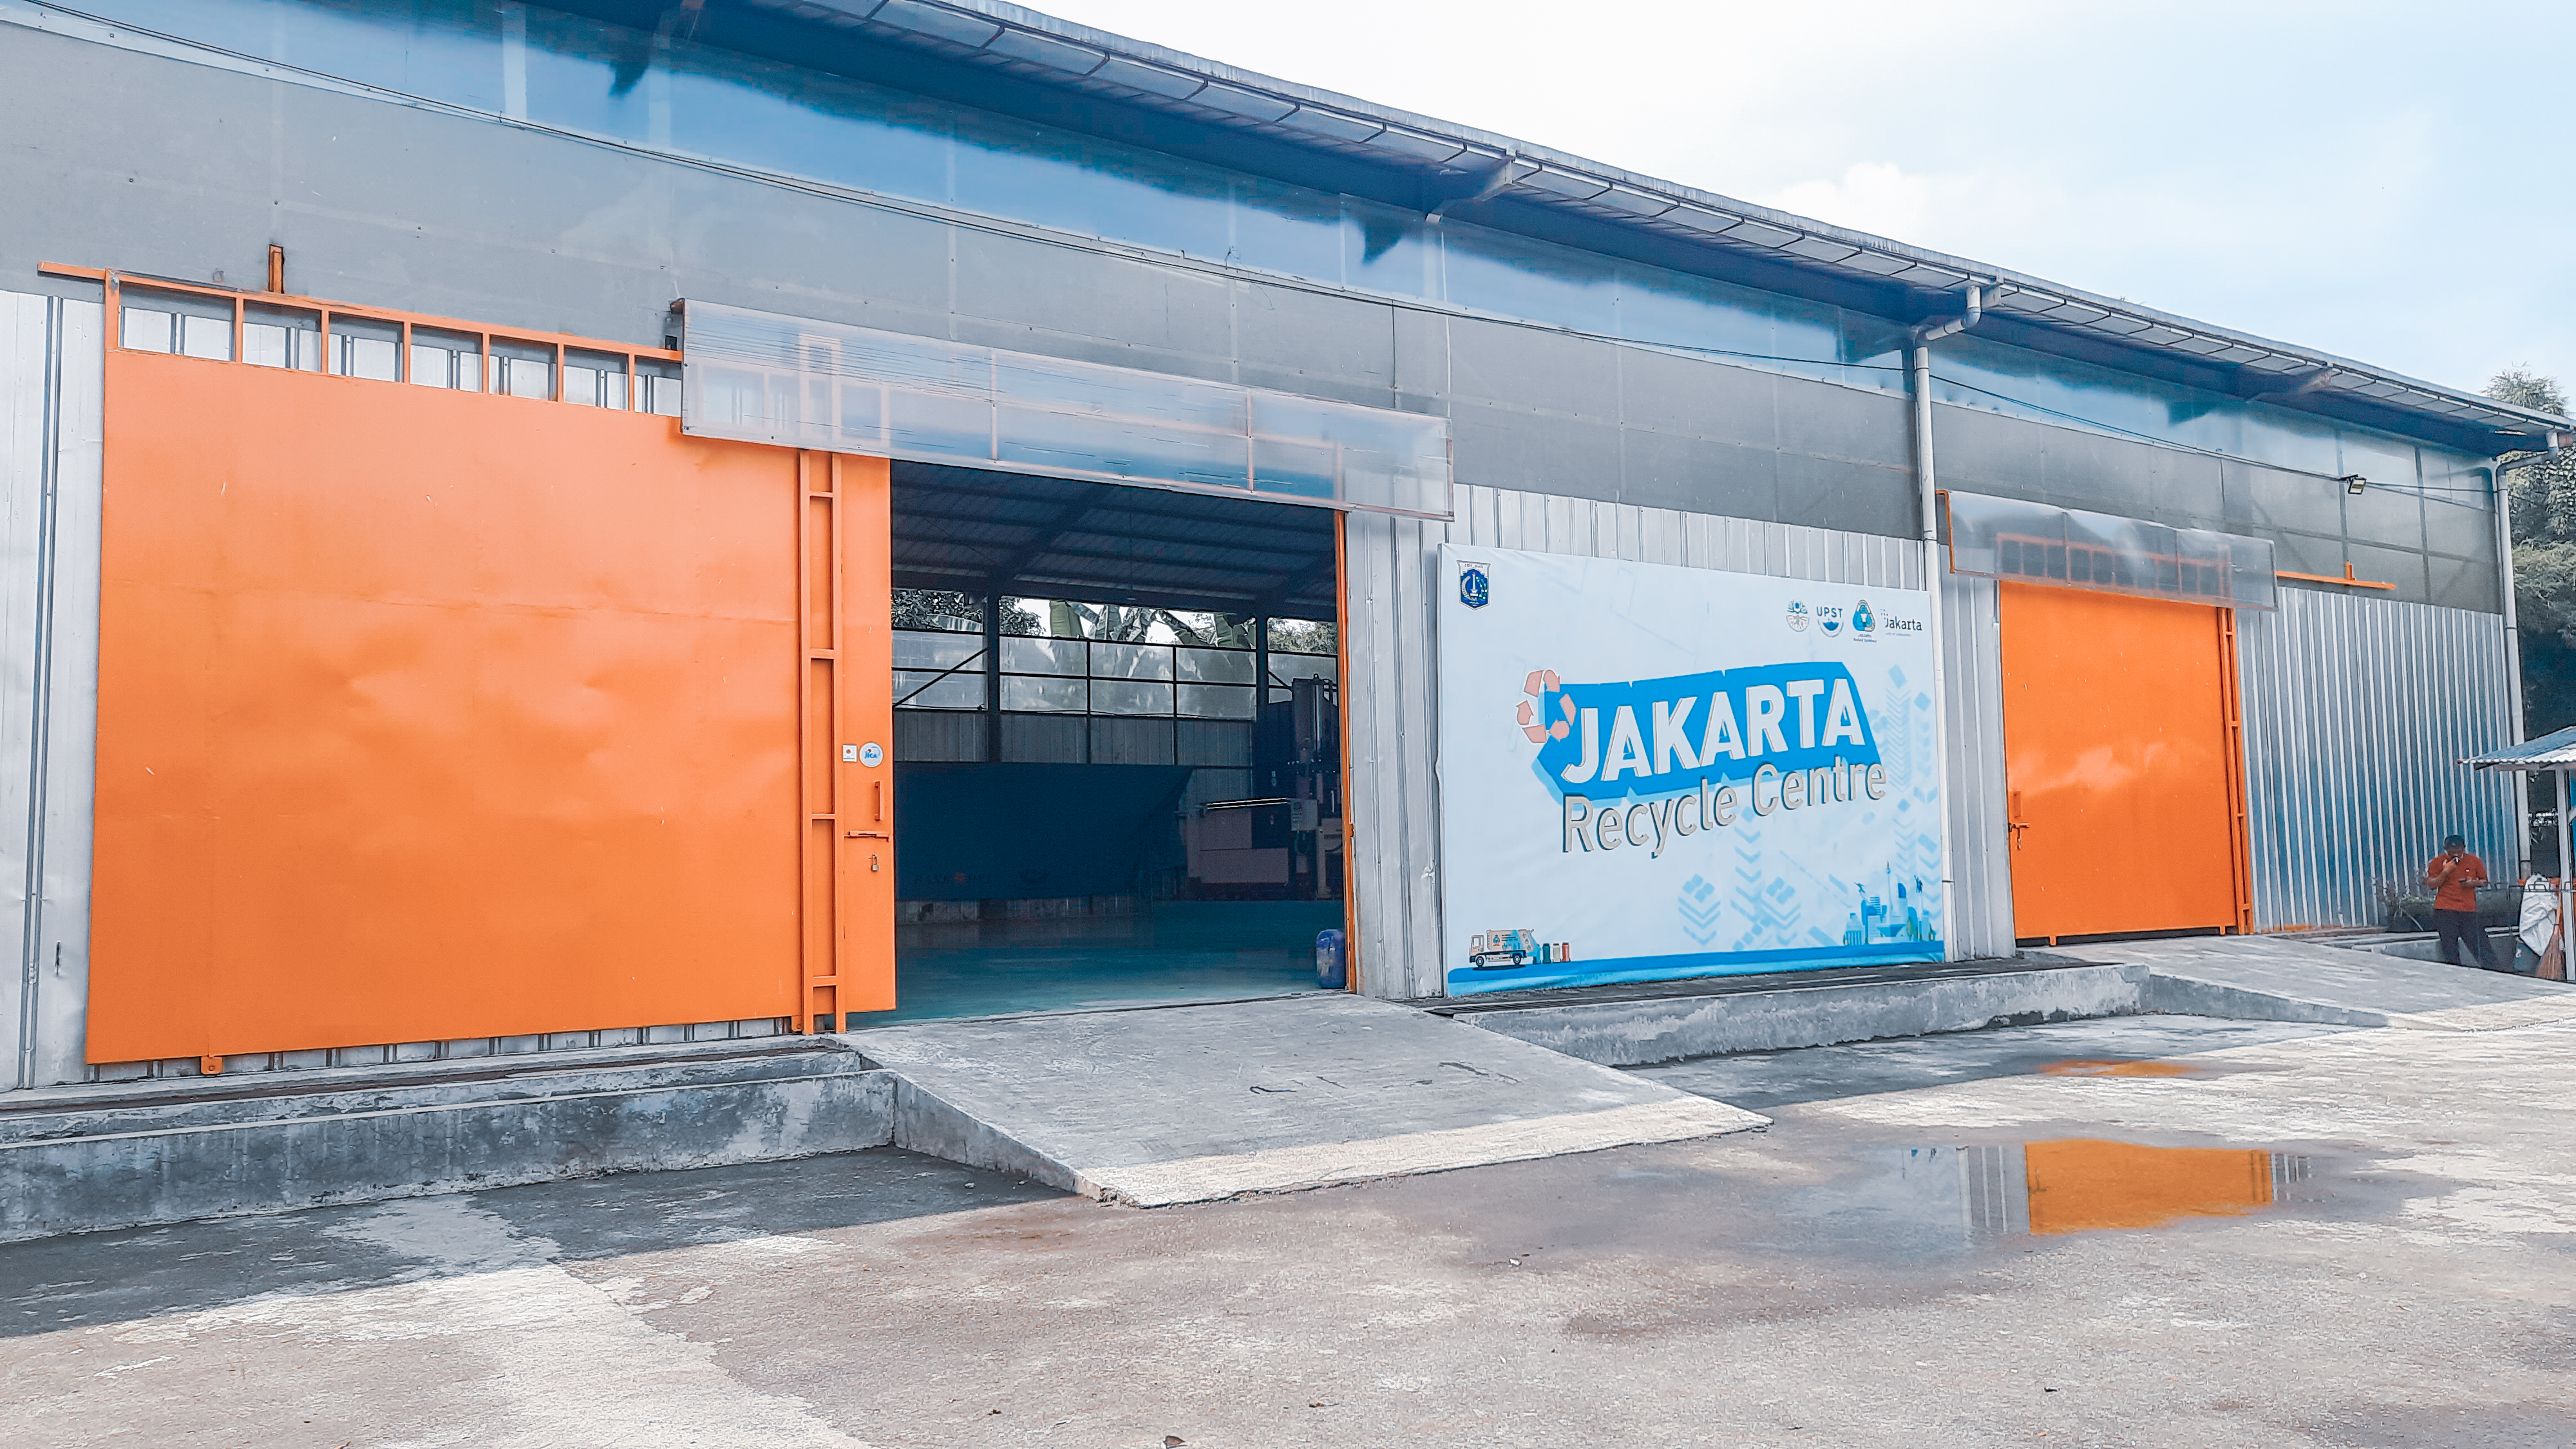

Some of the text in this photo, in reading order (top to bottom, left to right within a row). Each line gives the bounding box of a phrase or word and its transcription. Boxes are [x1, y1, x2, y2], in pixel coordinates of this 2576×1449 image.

[1816, 605, 1843, 618] UPST
[1560, 678, 1865, 784] JAKARTA
[1562, 755, 1887, 858] Recycle Centre
